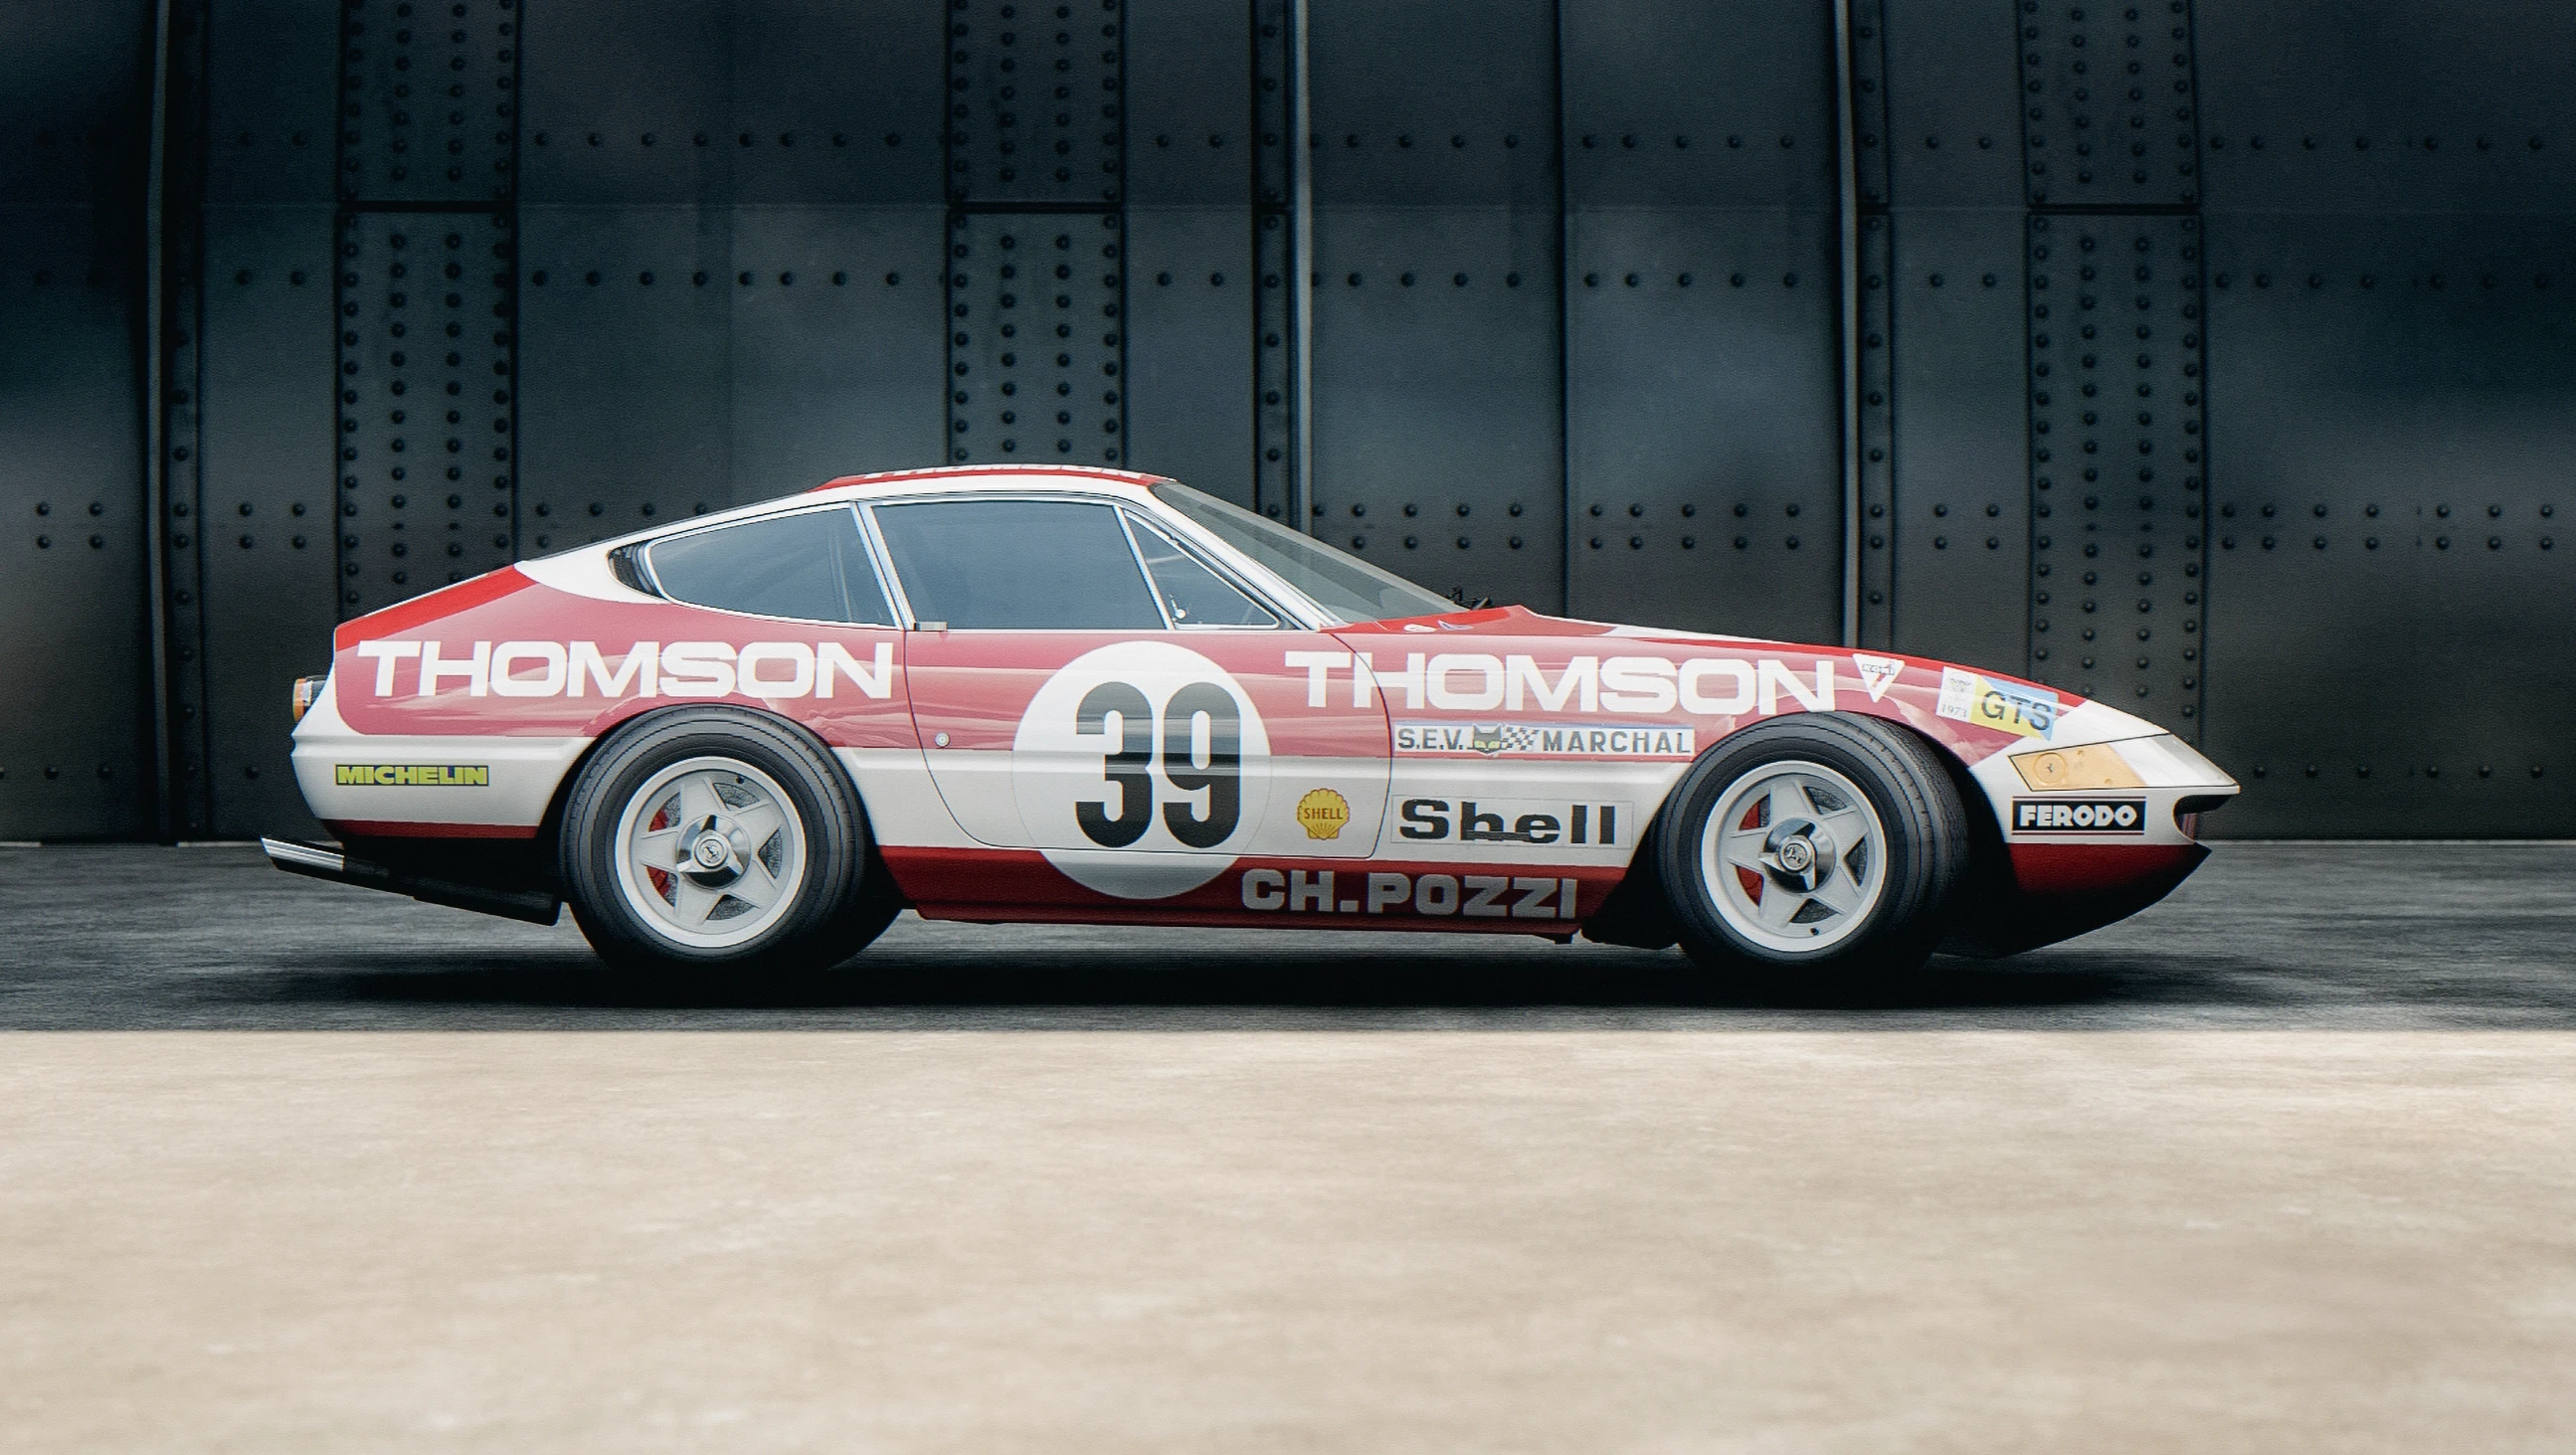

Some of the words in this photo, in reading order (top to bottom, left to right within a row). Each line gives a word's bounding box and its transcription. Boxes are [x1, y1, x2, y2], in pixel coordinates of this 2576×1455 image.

[358, 639, 893, 699] THOMSON
[1285, 650, 1835, 715] THOMSON
[1941, 704, 1967, 717] 1973
[1981, 690, 2052, 731] GTS
[1543, 730, 1692, 754] MARCHAL
[337, 766, 487, 785] MICHELIN
[1075, 681, 1241, 848] 39
[1303, 807, 1345, 820] SHELL
[1399, 799, 1616, 845] Shell
[2020, 805, 2137, 826] FERODO
